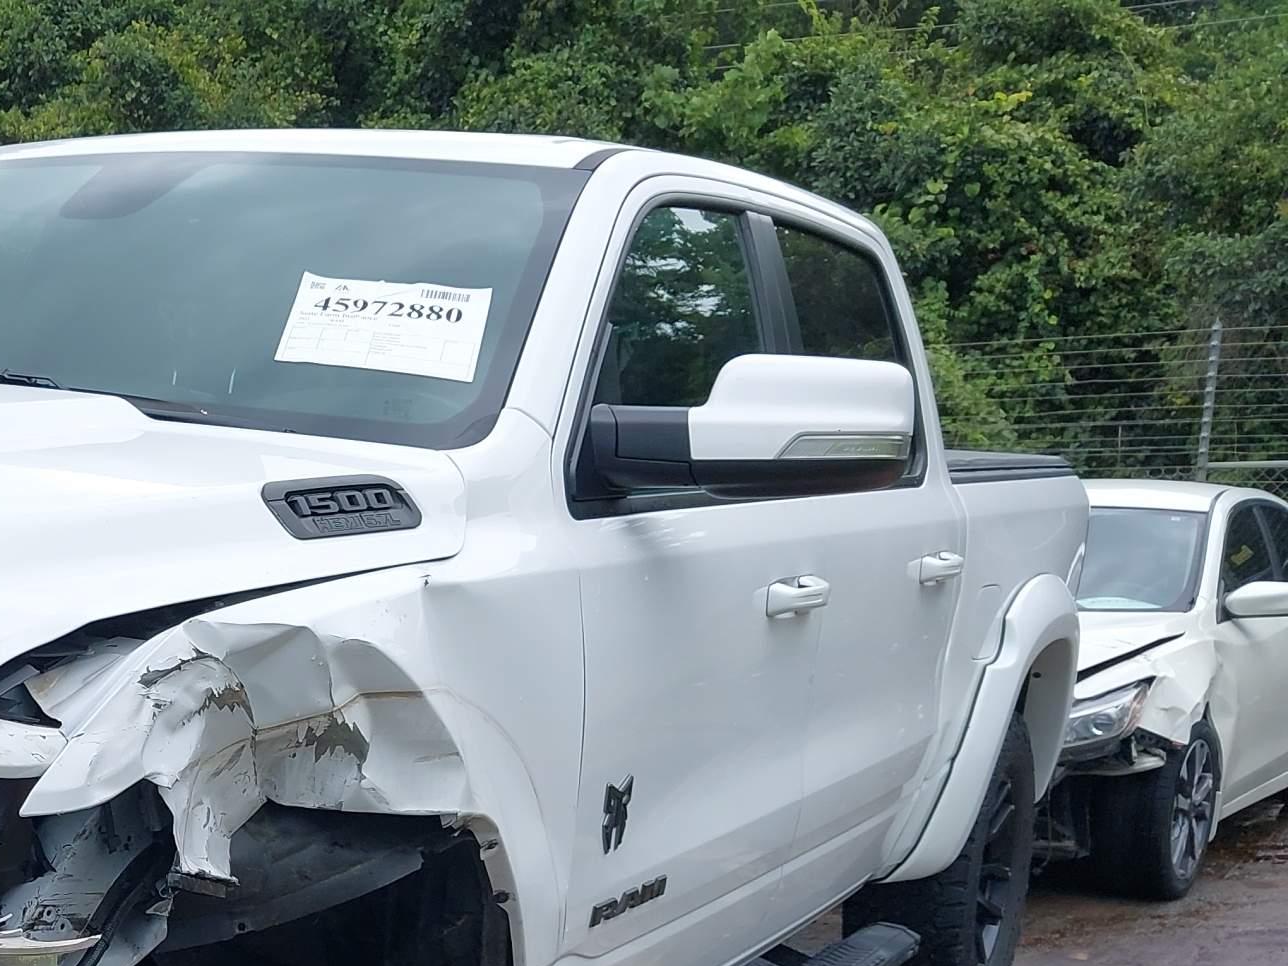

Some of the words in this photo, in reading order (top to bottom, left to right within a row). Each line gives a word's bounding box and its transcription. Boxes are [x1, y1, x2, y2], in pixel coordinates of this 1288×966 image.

[313, 296, 463, 324] 45972880
[286, 488, 394, 517] 1500
[313, 515, 360, 533] HEMI
[360, 512, 401, 528] 5.7L
[588, 874, 668, 929] RAM
